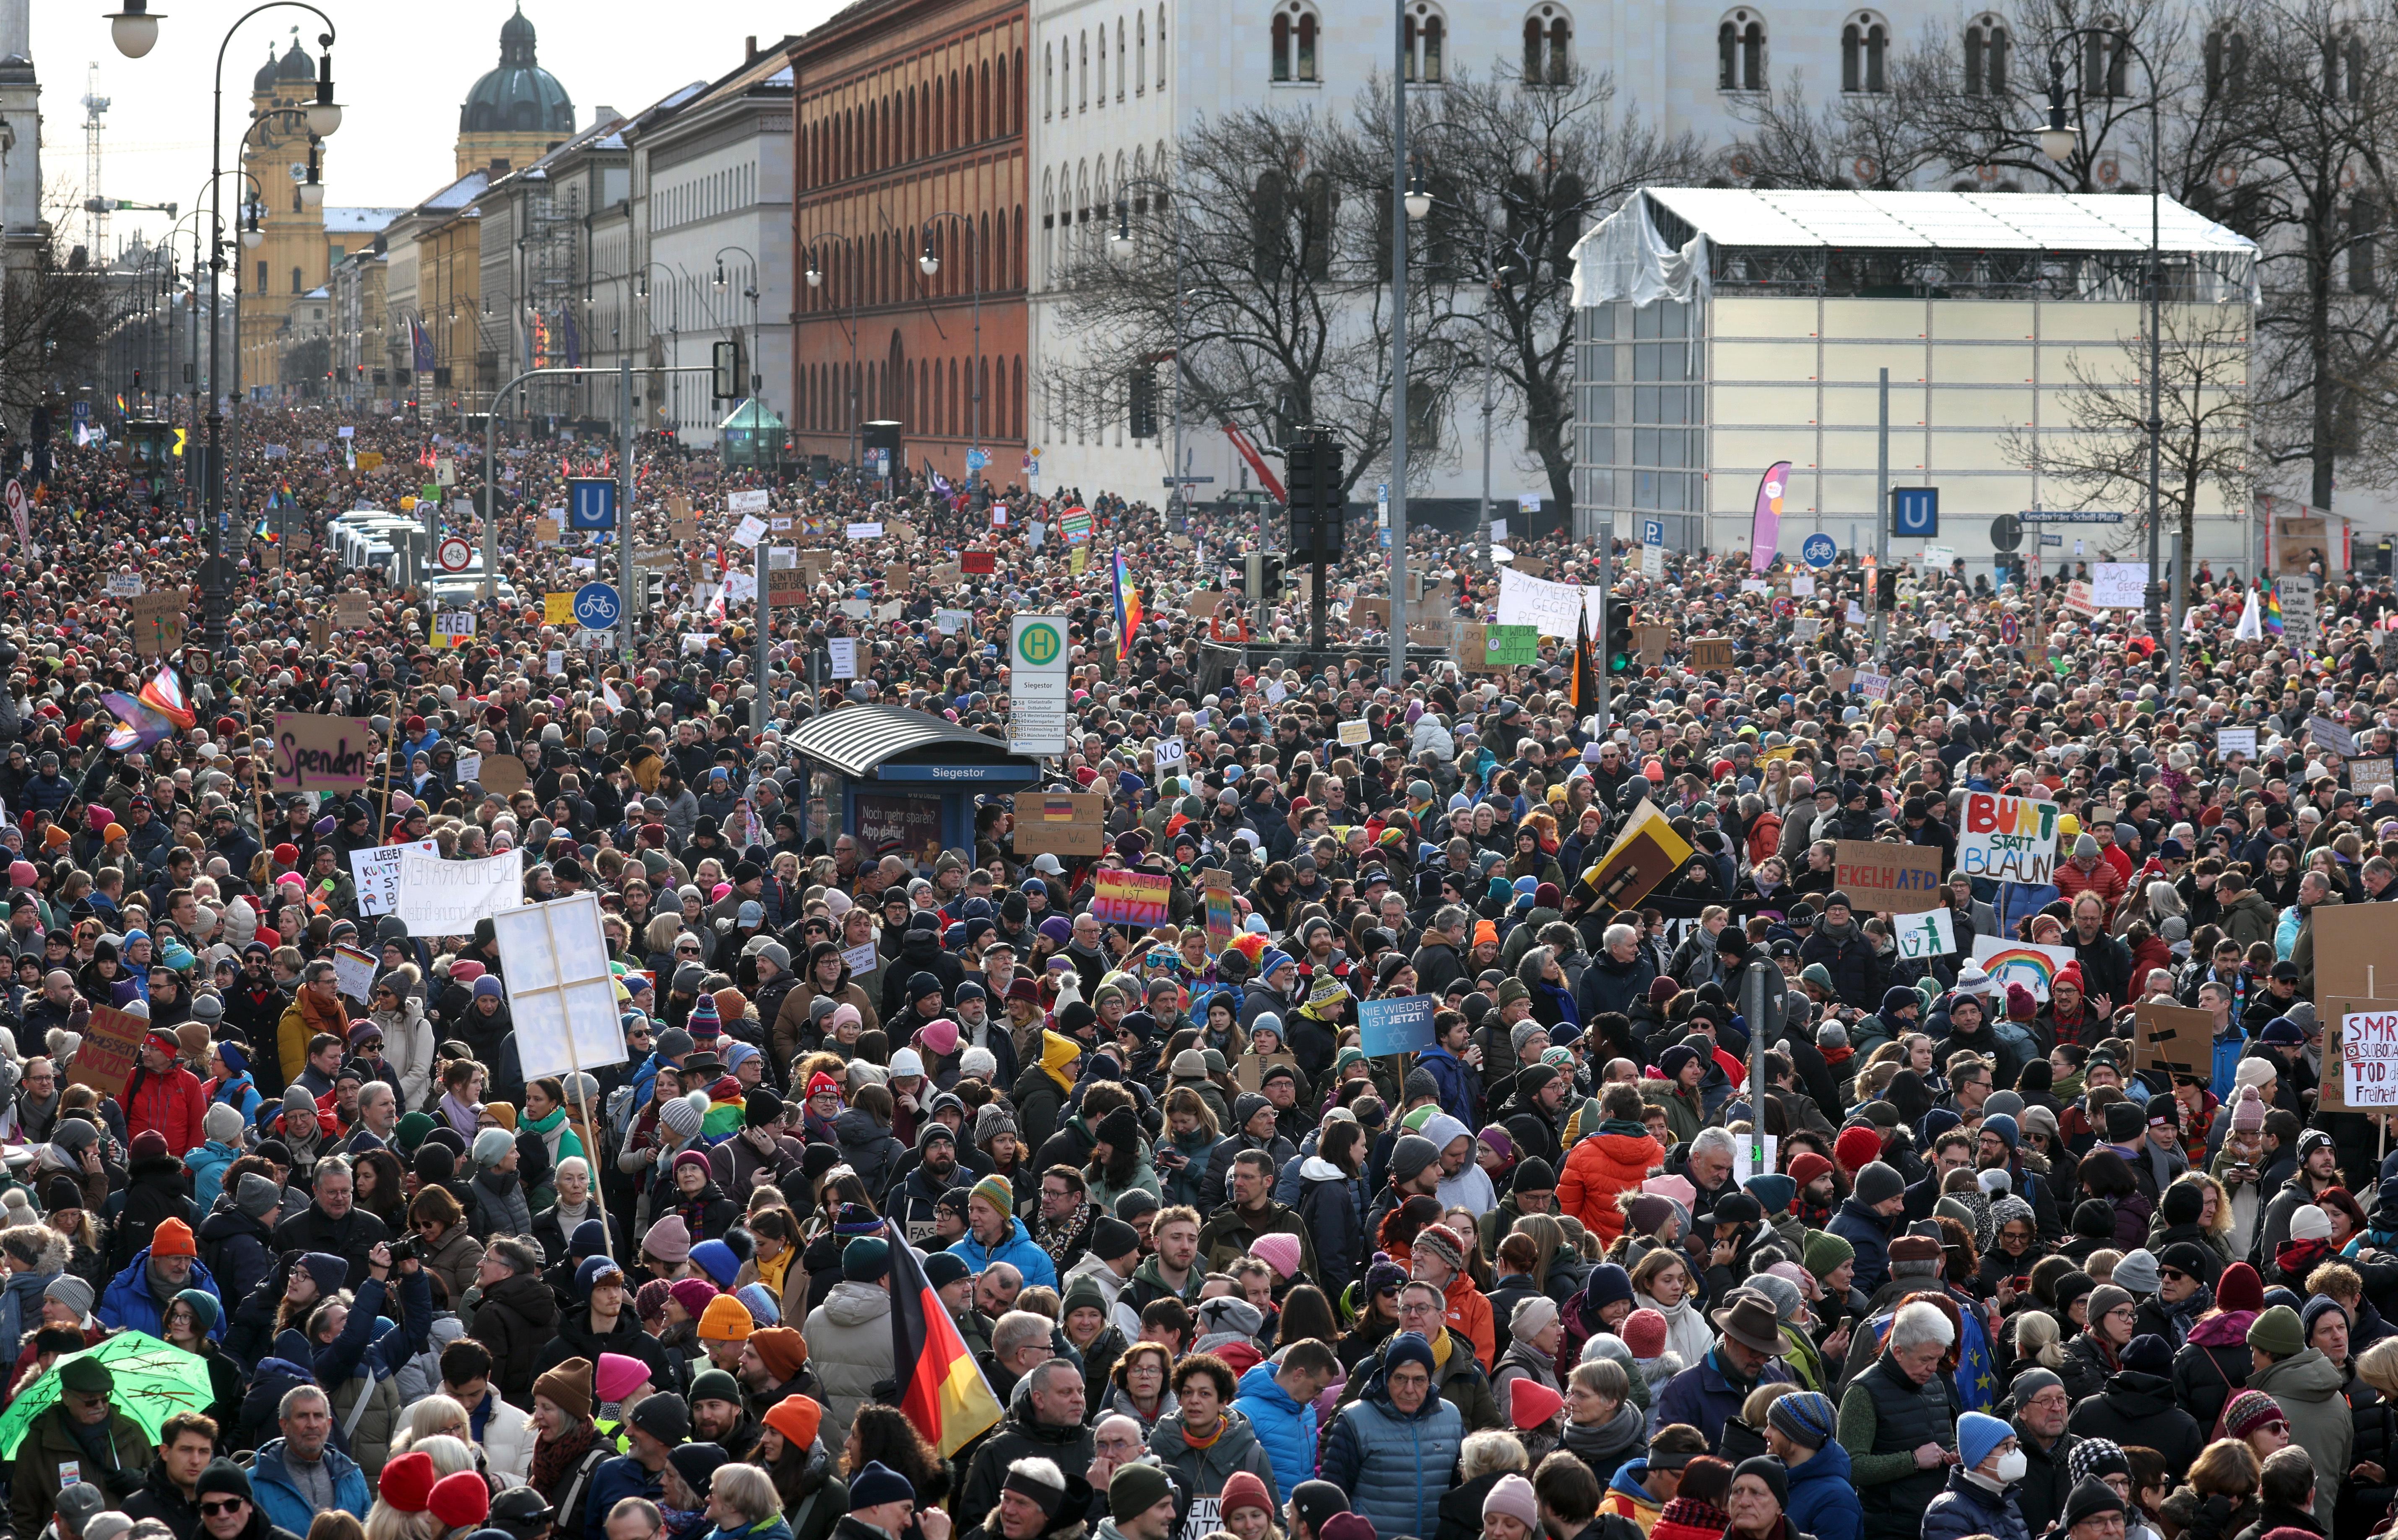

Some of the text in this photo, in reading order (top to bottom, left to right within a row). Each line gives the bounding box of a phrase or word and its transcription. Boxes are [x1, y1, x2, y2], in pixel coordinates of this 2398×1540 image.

[76, 404, 84, 415] U
[880, 450, 885, 459] P
[1031, 463, 1036, 474] P
[1380, 486, 1385, 500] P
[582, 489, 604, 521] U
[1906, 497, 1927, 528] U
[1061, 510, 1087, 519] MÜNCHEN
[1062, 515, 1090, 525] GEMEINSAM
[2024, 513, 2118, 523] Geschwister-Scholl-Platz
[1646, 523, 1658, 541] P
[2103, 569, 2129, 582] AWO
[2117, 582, 2145, 592] GEGE
[136, 596, 177, 606] RASSISMUS
[2099, 593, 2141, 604] RECHTS
[1532, 598, 1577, 617] GEGEN
[436, 615, 472, 634] EKEL
[1492, 625, 1538, 637] NIE WIEDER
[1519, 612, 1576, 636] RECHTS
[1031, 632, 1048, 656] H
[1506, 637, 1519, 648] IST
[1500, 648, 1532, 661] JETZT
[424, 666, 455, 684] FCK
[1860, 674, 1890, 688] LIBERTÉ
[276, 732, 365, 787] Spenden
[1157, 742, 1182, 763] NO
[932, 767, 985, 780] Siegestor
[2352, 762, 2368, 774] KEIN
[2355, 773, 2380, 782] BREIT
[863, 805, 936, 826] Noch mehr sparen?
[1074, 808, 1095, 820] Mut
[1966, 793, 2058, 842] BUNT
[862, 823, 905, 840] App dafür!
[1068, 832, 1086, 844] Wut
[1990, 834, 2036, 852] STATT
[1850, 844, 1928, 862] NAZIS RAUS
[1965, 847, 2053, 884] BLAUN
[1098, 871, 1169, 891] NIE WIEDER
[1122, 888, 1144, 901] IST
[1856, 892, 1868, 903] IST
[1873, 894, 1895, 907] KEINE
[1901, 895, 1938, 909] MEINUNG
[1096, 897, 1167, 926] JETZT!
[1904, 930, 1918, 939] AFD
[856, 947, 871, 956] HÖCKE
[349, 978, 363, 990] NAZIS
[1361, 1000, 1429, 1018] NIE WIEDER
[91, 1008, 145, 1041] ALLE
[1368, 1012, 1424, 1027] IST JETZT!
[83, 1026, 138, 1058] hassen
[73, 1044, 133, 1082] NAZIS
[2351, 1062, 2387, 1084] TOD
[2356, 1085, 2396, 1104] Freiheit
[2149, 1116, 2165, 1126] MARVEL
[1190, 1499, 1222, 1518] EIN
